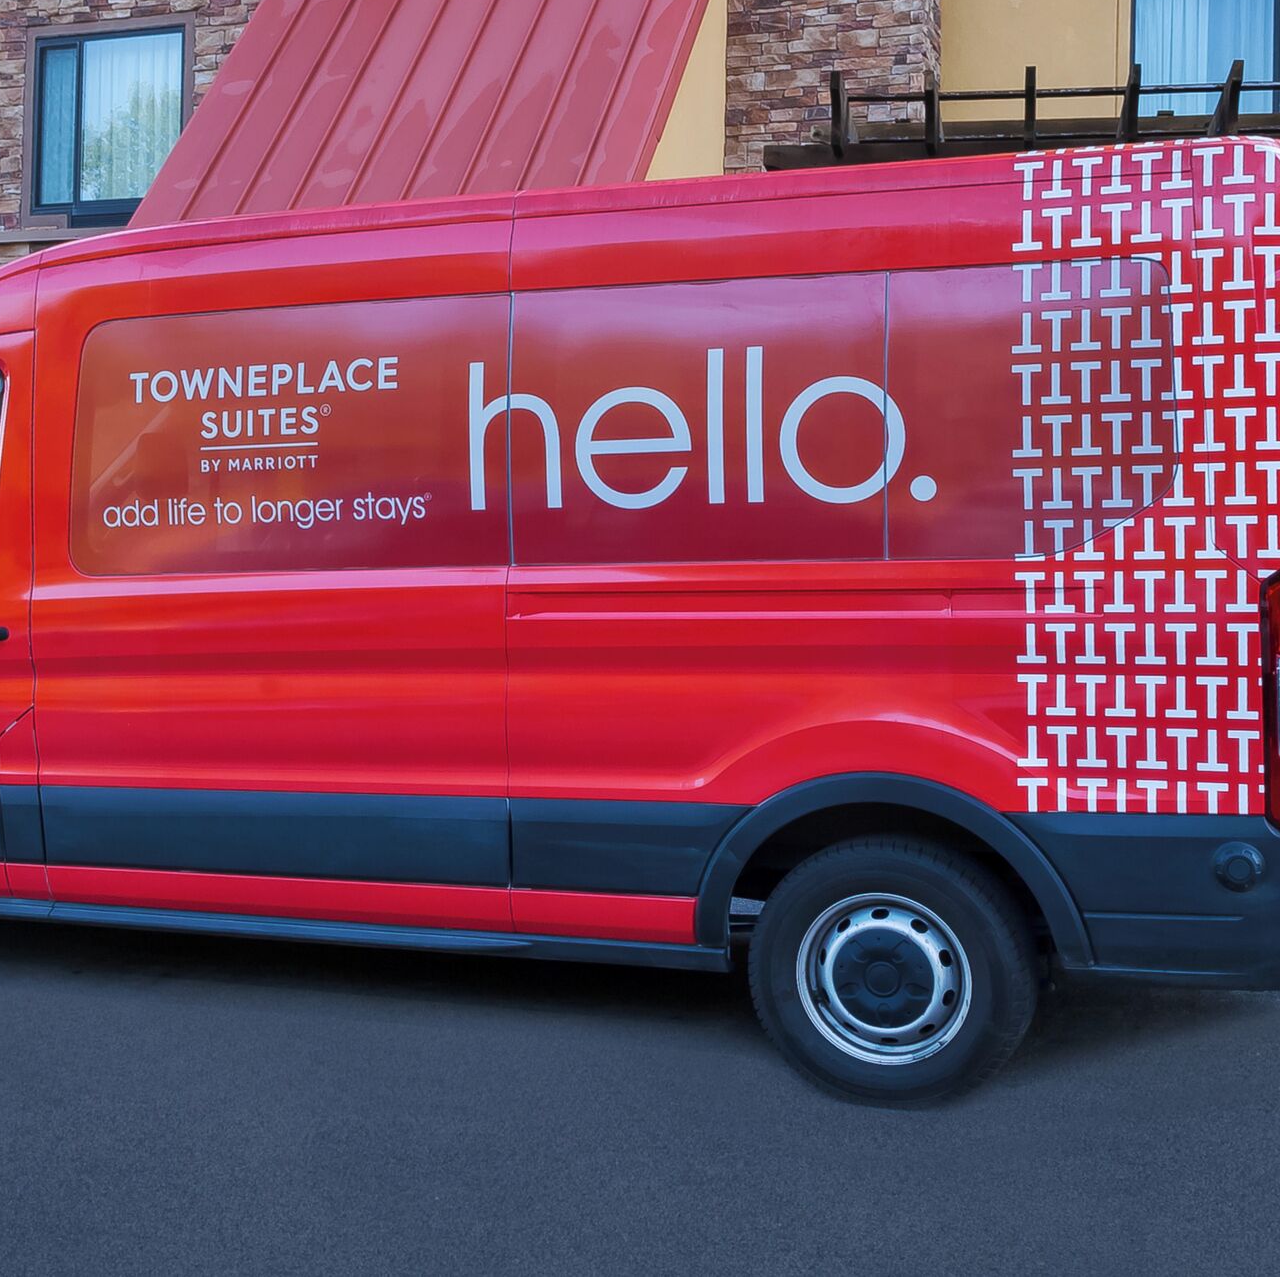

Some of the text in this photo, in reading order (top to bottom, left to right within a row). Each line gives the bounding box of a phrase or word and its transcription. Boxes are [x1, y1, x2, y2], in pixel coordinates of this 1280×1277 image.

[129, 356, 399, 403] TOWNEPLACE
[469, 345, 938, 512] hello.
[200, 454, 319, 473] BY MARRIOTT
[103, 498, 159, 528] add
[167, 497, 206, 526] life
[214, 496, 243, 524] to
[251, 495, 344, 530] longer
